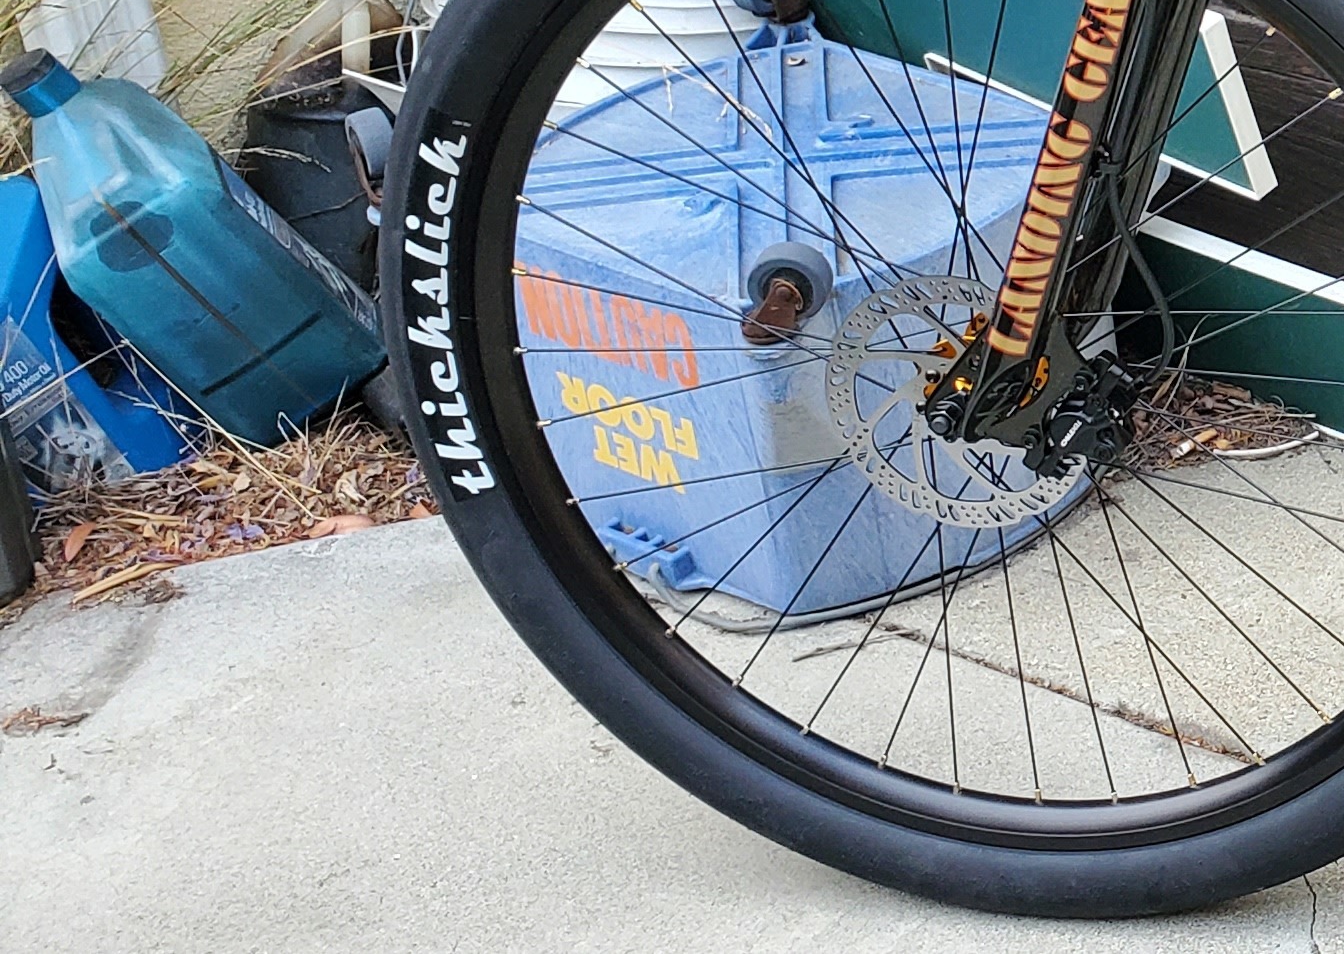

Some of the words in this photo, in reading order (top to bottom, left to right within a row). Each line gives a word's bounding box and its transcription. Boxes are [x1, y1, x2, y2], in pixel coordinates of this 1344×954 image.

[986, 110, 1092, 358] LANDING
[401, 133, 495, 496] thickslick
[513, 258, 701, 391] CAUTION
[3, 360, 29, 384] 400
[555, 370, 700, 461] FLOOR
[592, 424, 687, 495] WET
